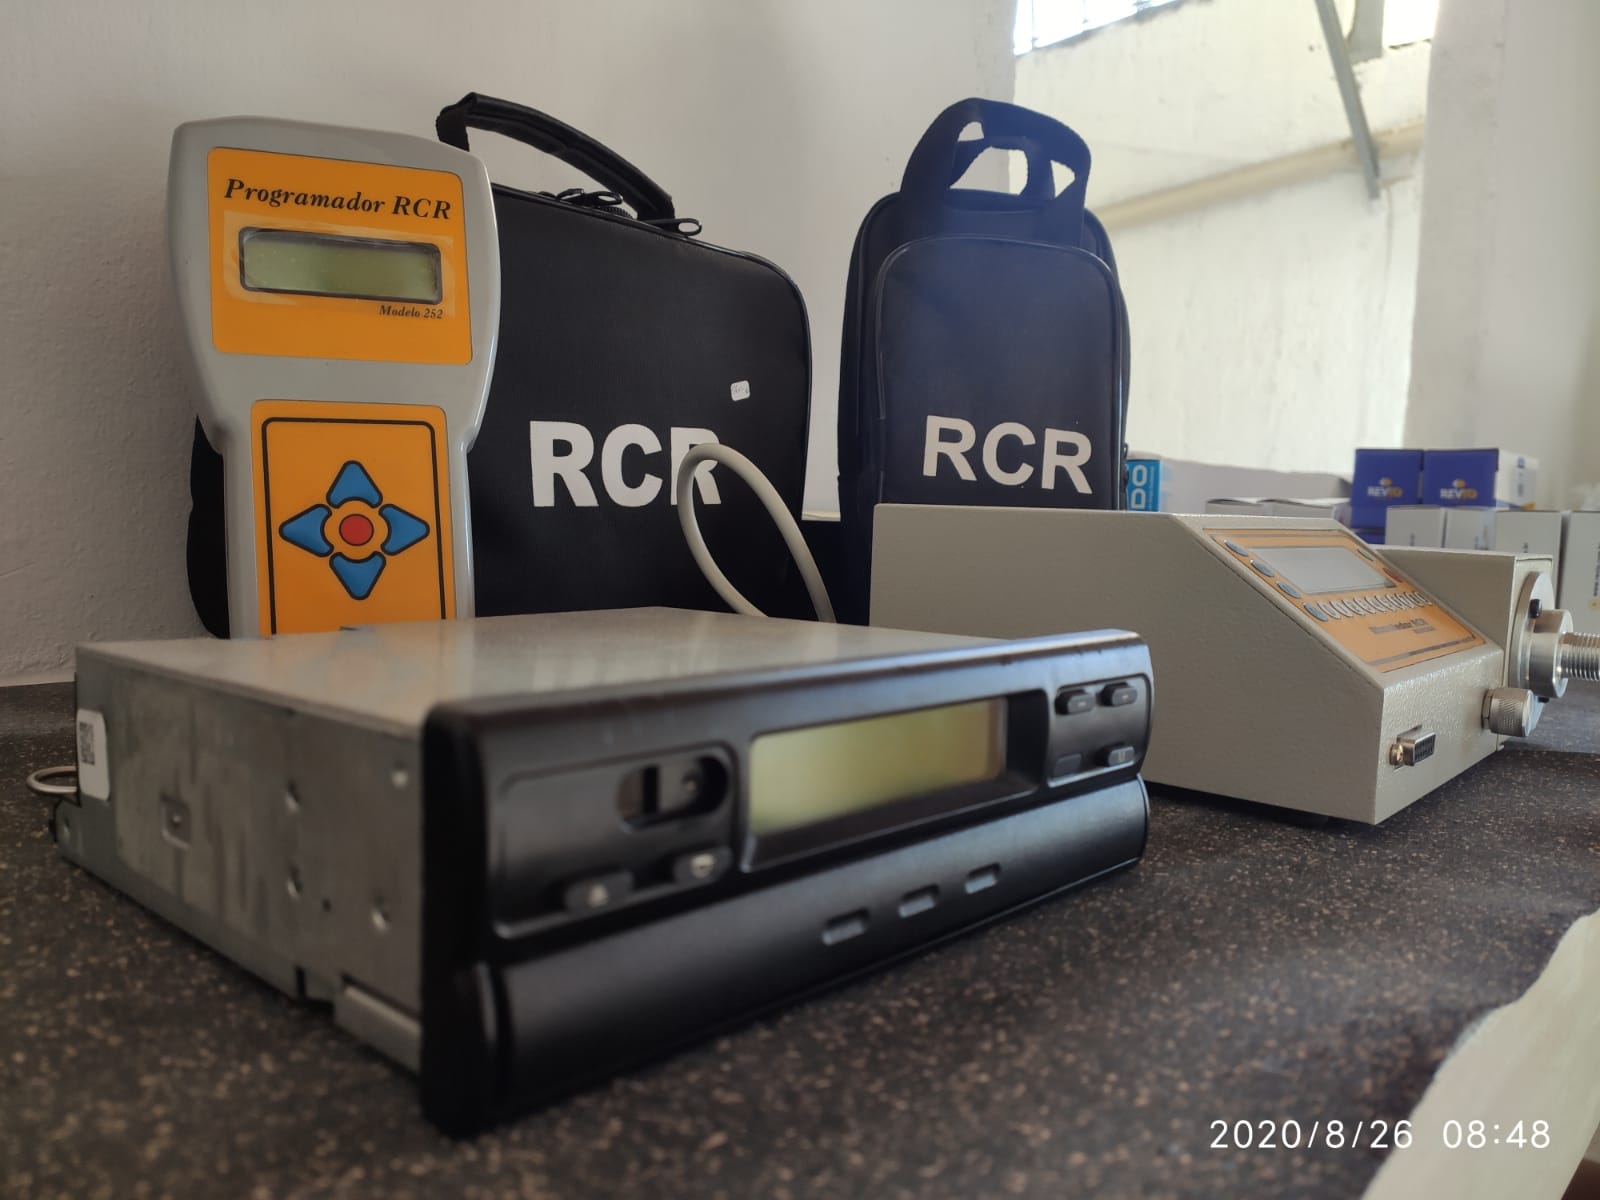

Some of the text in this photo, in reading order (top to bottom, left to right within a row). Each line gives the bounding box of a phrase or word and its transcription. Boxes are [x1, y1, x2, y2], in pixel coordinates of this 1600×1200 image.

[224, 178, 451, 220] Programador RCR
[379, 304, 443, 319] Modelo 252
[529, 420, 722, 508] RCR
[923, 415, 1093, 495] RCR
